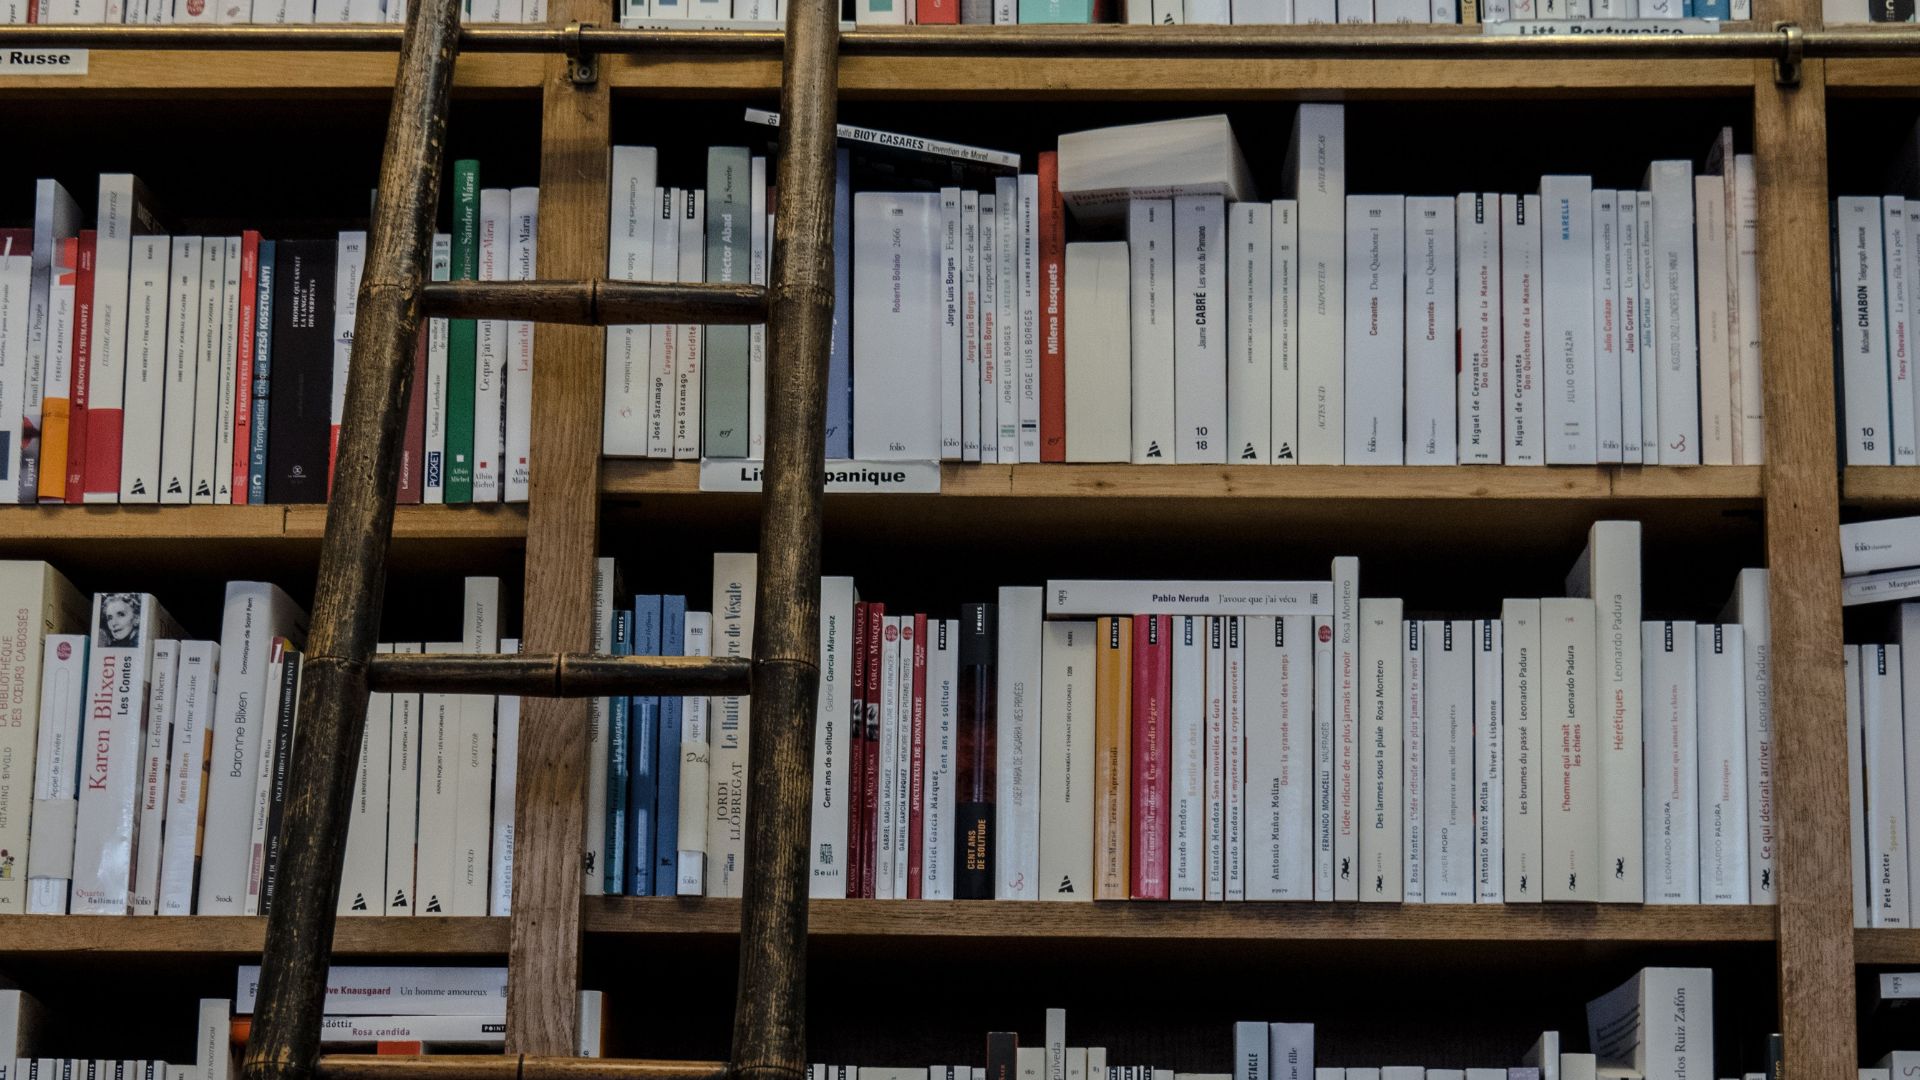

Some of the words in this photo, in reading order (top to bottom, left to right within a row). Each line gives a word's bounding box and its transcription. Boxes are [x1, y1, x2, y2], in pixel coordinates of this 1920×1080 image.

[10, 52, 70, 65] Russe
[854, 130, 877, 141] BIOY
[880, 134, 924, 150] CASARES
[928, 144, 960, 157] L'invention
[961, 147, 969, 157] de
[970, 148, 988, 160] Morel
[1318, 134, 1326, 165] CERCAS
[462, 173, 474, 202] Márai
[1318, 167, 1327, 193] JAVIER
[460, 206, 473, 244] Sándor
[722, 214, 733, 242] Abad
[1561, 199, 1570, 240] MARELLE
[893, 228, 901, 247] 2666
[946, 221, 954, 250] Fictions
[1198, 226, 1206, 251] Pamano
[1857, 227, 1866, 249] Avenue
[722, 246, 732, 281] Héctor
[892, 254, 901, 281] Bolaño
[946, 257, 956, 284] Borges
[1858, 251, 1867, 281] Telegraph
[946, 286, 955, 302] Luis
[1049, 264, 1059, 314] Busquets
[1480, 265, 1488, 297] Manche
[259, 266, 271, 330] KOSZTOLÁNYI
[892, 283, 901, 313] Roberto
[1195, 293, 1206, 325] CABRÉ
[1858, 286, 1869, 327] CHABON
[78, 304, 89, 354] L'HUMANITÉ
[946, 305, 956, 326] Jorge
[1480, 311, 1488, 321] de
[241, 305, 250, 360] CLEPTOMANE
[688, 326, 697, 362] lucidité
[1048, 317, 1058, 354] Milena
[1197, 328, 1207, 349] Jaume
[1480, 325, 1489, 368] Quichotte
[1861, 329, 1869, 353] Michael
[1564, 330, 1575, 375] CORTÁZAR
[76, 357, 88, 395] DÉNONCE
[256, 363, 267, 396] tchèque
[688, 364, 696, 373] La
[1472, 353, 1480, 397] Cervantes
[1480, 372, 1489, 388] Don
[239, 362, 249, 412] TRADUCTEUR
[653, 378, 662, 418] Saramago
[1566, 379, 1575, 403] JULIO
[1472, 400, 1480, 410] de
[255, 399, 267, 451] Trompettiste
[652, 422, 662, 440] José
[1196, 427, 1208, 435] 10
[1472, 414, 1481, 444] Miguel
[1862, 427, 1874, 436] 10
[255, 453, 264, 464] Le
[1196, 441, 1208, 450] 18
[1862, 442, 1874, 451] 18
[25, 458, 36, 487] Fayard
[429, 452, 440, 486] POCKET
[741, 468, 763, 481] Lit
[824, 469, 905, 485] panique
[1152, 594, 1176, 602] Pablo
[1178, 594, 1209, 602] Neruda
[1219, 594, 1246, 604] J'avoue
[1266, 595, 1276, 604] j'ai
[1278, 594, 1296, 603] vécu
[1342, 580, 1351, 620] Montero
[1612, 594, 1622, 630] Padura
[242, 630, 250, 638] de
[244, 612, 252, 628] Saint
[826, 616, 837, 652] Márquez
[1342, 623, 1351, 643] Rosa
[15, 608, 29, 662] CABOSSÉS
[241, 640, 251, 675] Dominique
[1342, 652, 1351, 678] revoir
[1613, 633, 1623, 682] Leonardo
[1755, 645, 1766, 681] Padura
[13, 666, 25, 704] CŒURS
[93, 655, 116, 720] Blixen
[119, 656, 132, 693] Contes
[154, 672, 166, 701] Babette
[1343, 681, 1351, 689] te
[118, 696, 129, 715] Les
[154, 703, 162, 712] de
[234, 692, 248, 724] Blixen
[825, 684, 834, 712] Gabriel
[1212, 698, 1220, 718] Gurb
[1342, 692, 1353, 722] jamais
[1756, 684, 1767, 733] Leonardo
[12, 708, 22, 727] DES
[151, 712, 162, 734] festin
[1212, 722, 1220, 731] de
[1489, 700, 1497, 738] Lisbonne
[1612, 689, 1626, 750] Hérétiques
[152, 737, 161, 748] Le
[823, 722, 833, 755] solitude
[1342, 725, 1353, 744] plus
[89, 730, 110, 789] Karen
[231, 727, 245, 777] Baronne
[824, 757, 832, 768] de
[1212, 735, 1220, 776] nouvelles
[1342, 760, 1351, 771] de
[1343, 746, 1351, 757] ne
[1489, 750, 1498, 779] L'hiver
[1758, 741, 1769, 777] arriver
[148, 757, 159, 784] Blixen
[147, 787, 158, 810] Karen
[717, 782, 729, 821] JORDI
[730, 762, 743, 840] LLOBREGAT
[823, 788, 833, 808] Cent
[1212, 780, 1220, 800] Sans
[1342, 773, 1351, 807] ridicule
[1480, 782, 1488, 812] Molina
[1759, 781, 1771, 824] désirait
[1212, 802, 1220, 841] Mendoza
[1342, 810, 1351, 835] L'idée
[1480, 816, 1489, 844] Muñoz
[1760, 828, 1773, 843] qui
[504, 825, 514, 860] Gaarder
[968, 831, 976, 848] ANS
[976, 819, 986, 858] SOLITUDE
[1760, 845, 1771, 860] Ce
[968, 851, 976, 869] CENT
[976, 861, 985, 869] DE
[1212, 844, 1220, 881] Eduardo
[1481, 848, 1489, 884] Antonio
[1882, 854, 1890, 884] Dexter
[503, 865, 513, 899] Jostein
[1883, 888, 1892, 908] Pete
[341, 986, 391, 996] Knausgaard
[400, 987, 412, 996] Un
[415, 987, 444, 996] homme
[1674, 986, 1686, 1022] Zafón
[353, 1028, 372, 1036] Rosa
[376, 1027, 410, 1036] candida
[1674, 1024, 1686, 1052] Ruiz
